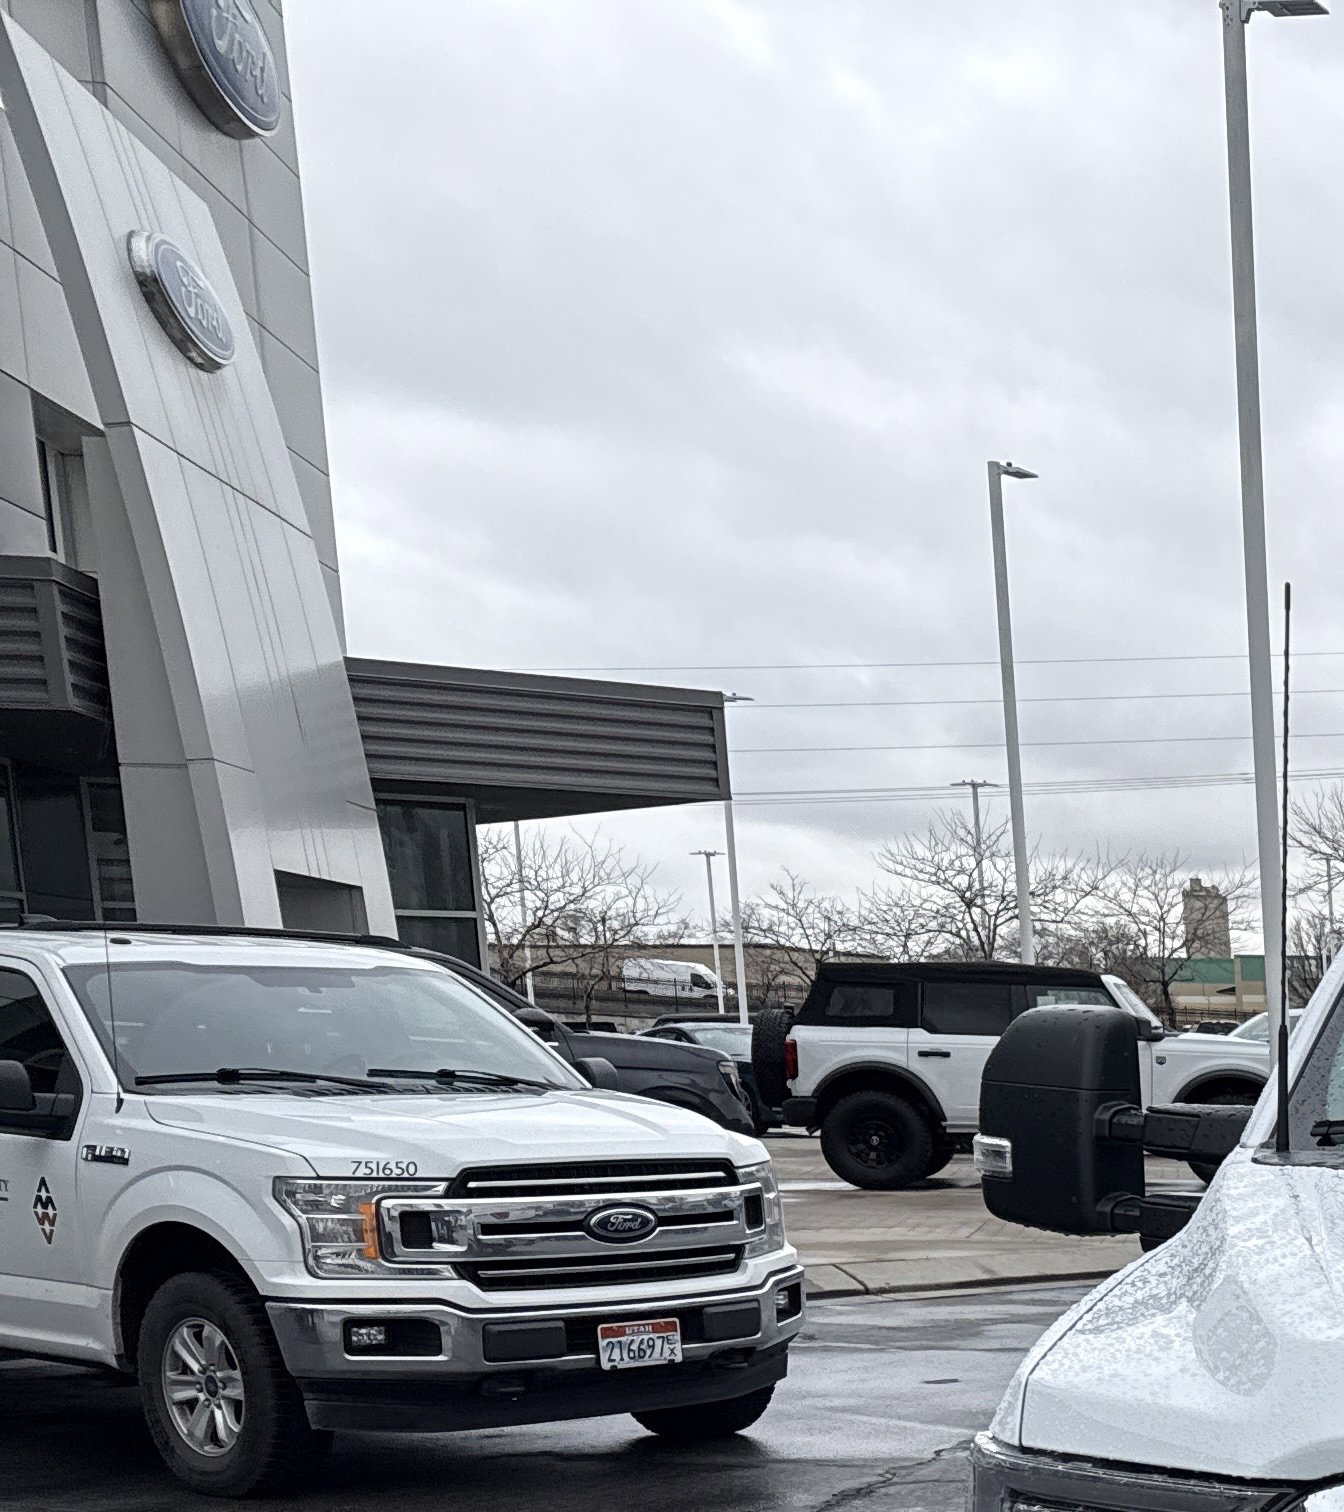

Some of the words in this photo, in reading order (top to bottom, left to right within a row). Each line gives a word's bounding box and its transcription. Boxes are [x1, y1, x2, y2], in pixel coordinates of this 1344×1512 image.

[176, 260, 226, 343] Ford
[350, 1160, 418, 1177] 751650
[607, 1214, 642, 1231] Ford
[606, 1335, 666, 1363] 216697
